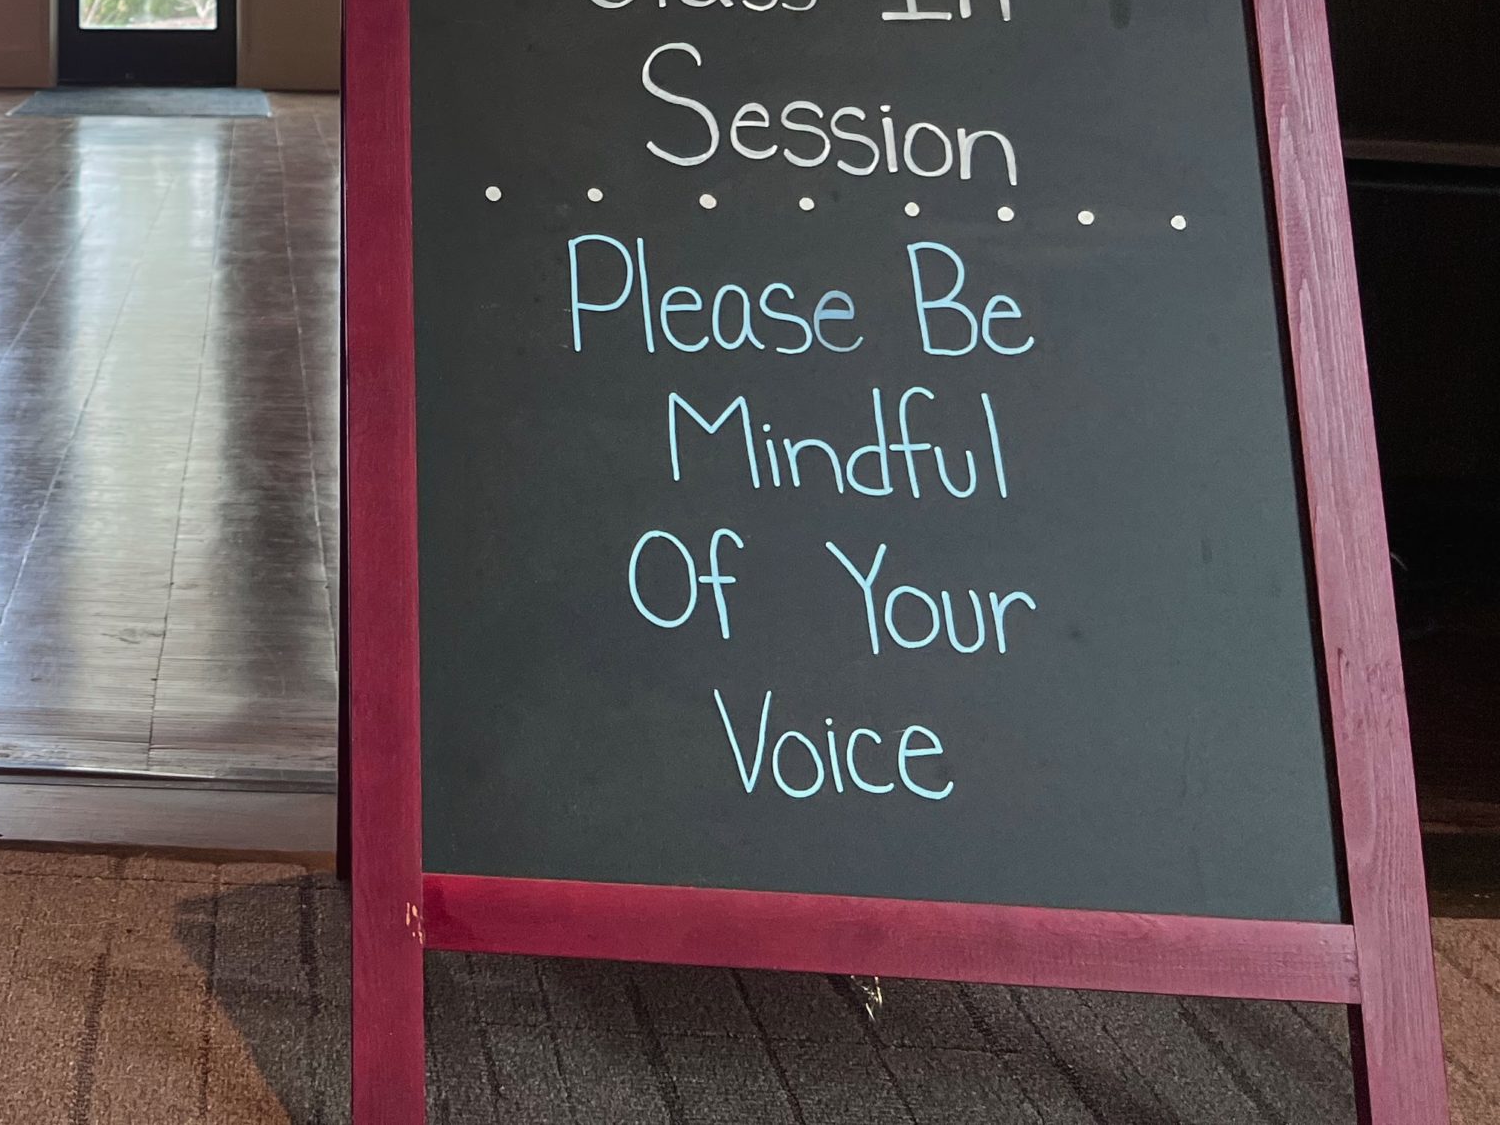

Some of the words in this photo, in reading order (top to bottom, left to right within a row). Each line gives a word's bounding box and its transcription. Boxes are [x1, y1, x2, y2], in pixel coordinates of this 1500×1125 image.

[641, 42, 1018, 186] Session
[567, 234, 864, 355] Please
[906, 241, 1035, 357] Be
[668, 386, 1008, 499] Mindful
[628, 528, 745, 640] Of
[825, 541, 1037, 655] Your
[713, 688, 954, 800] Voice
